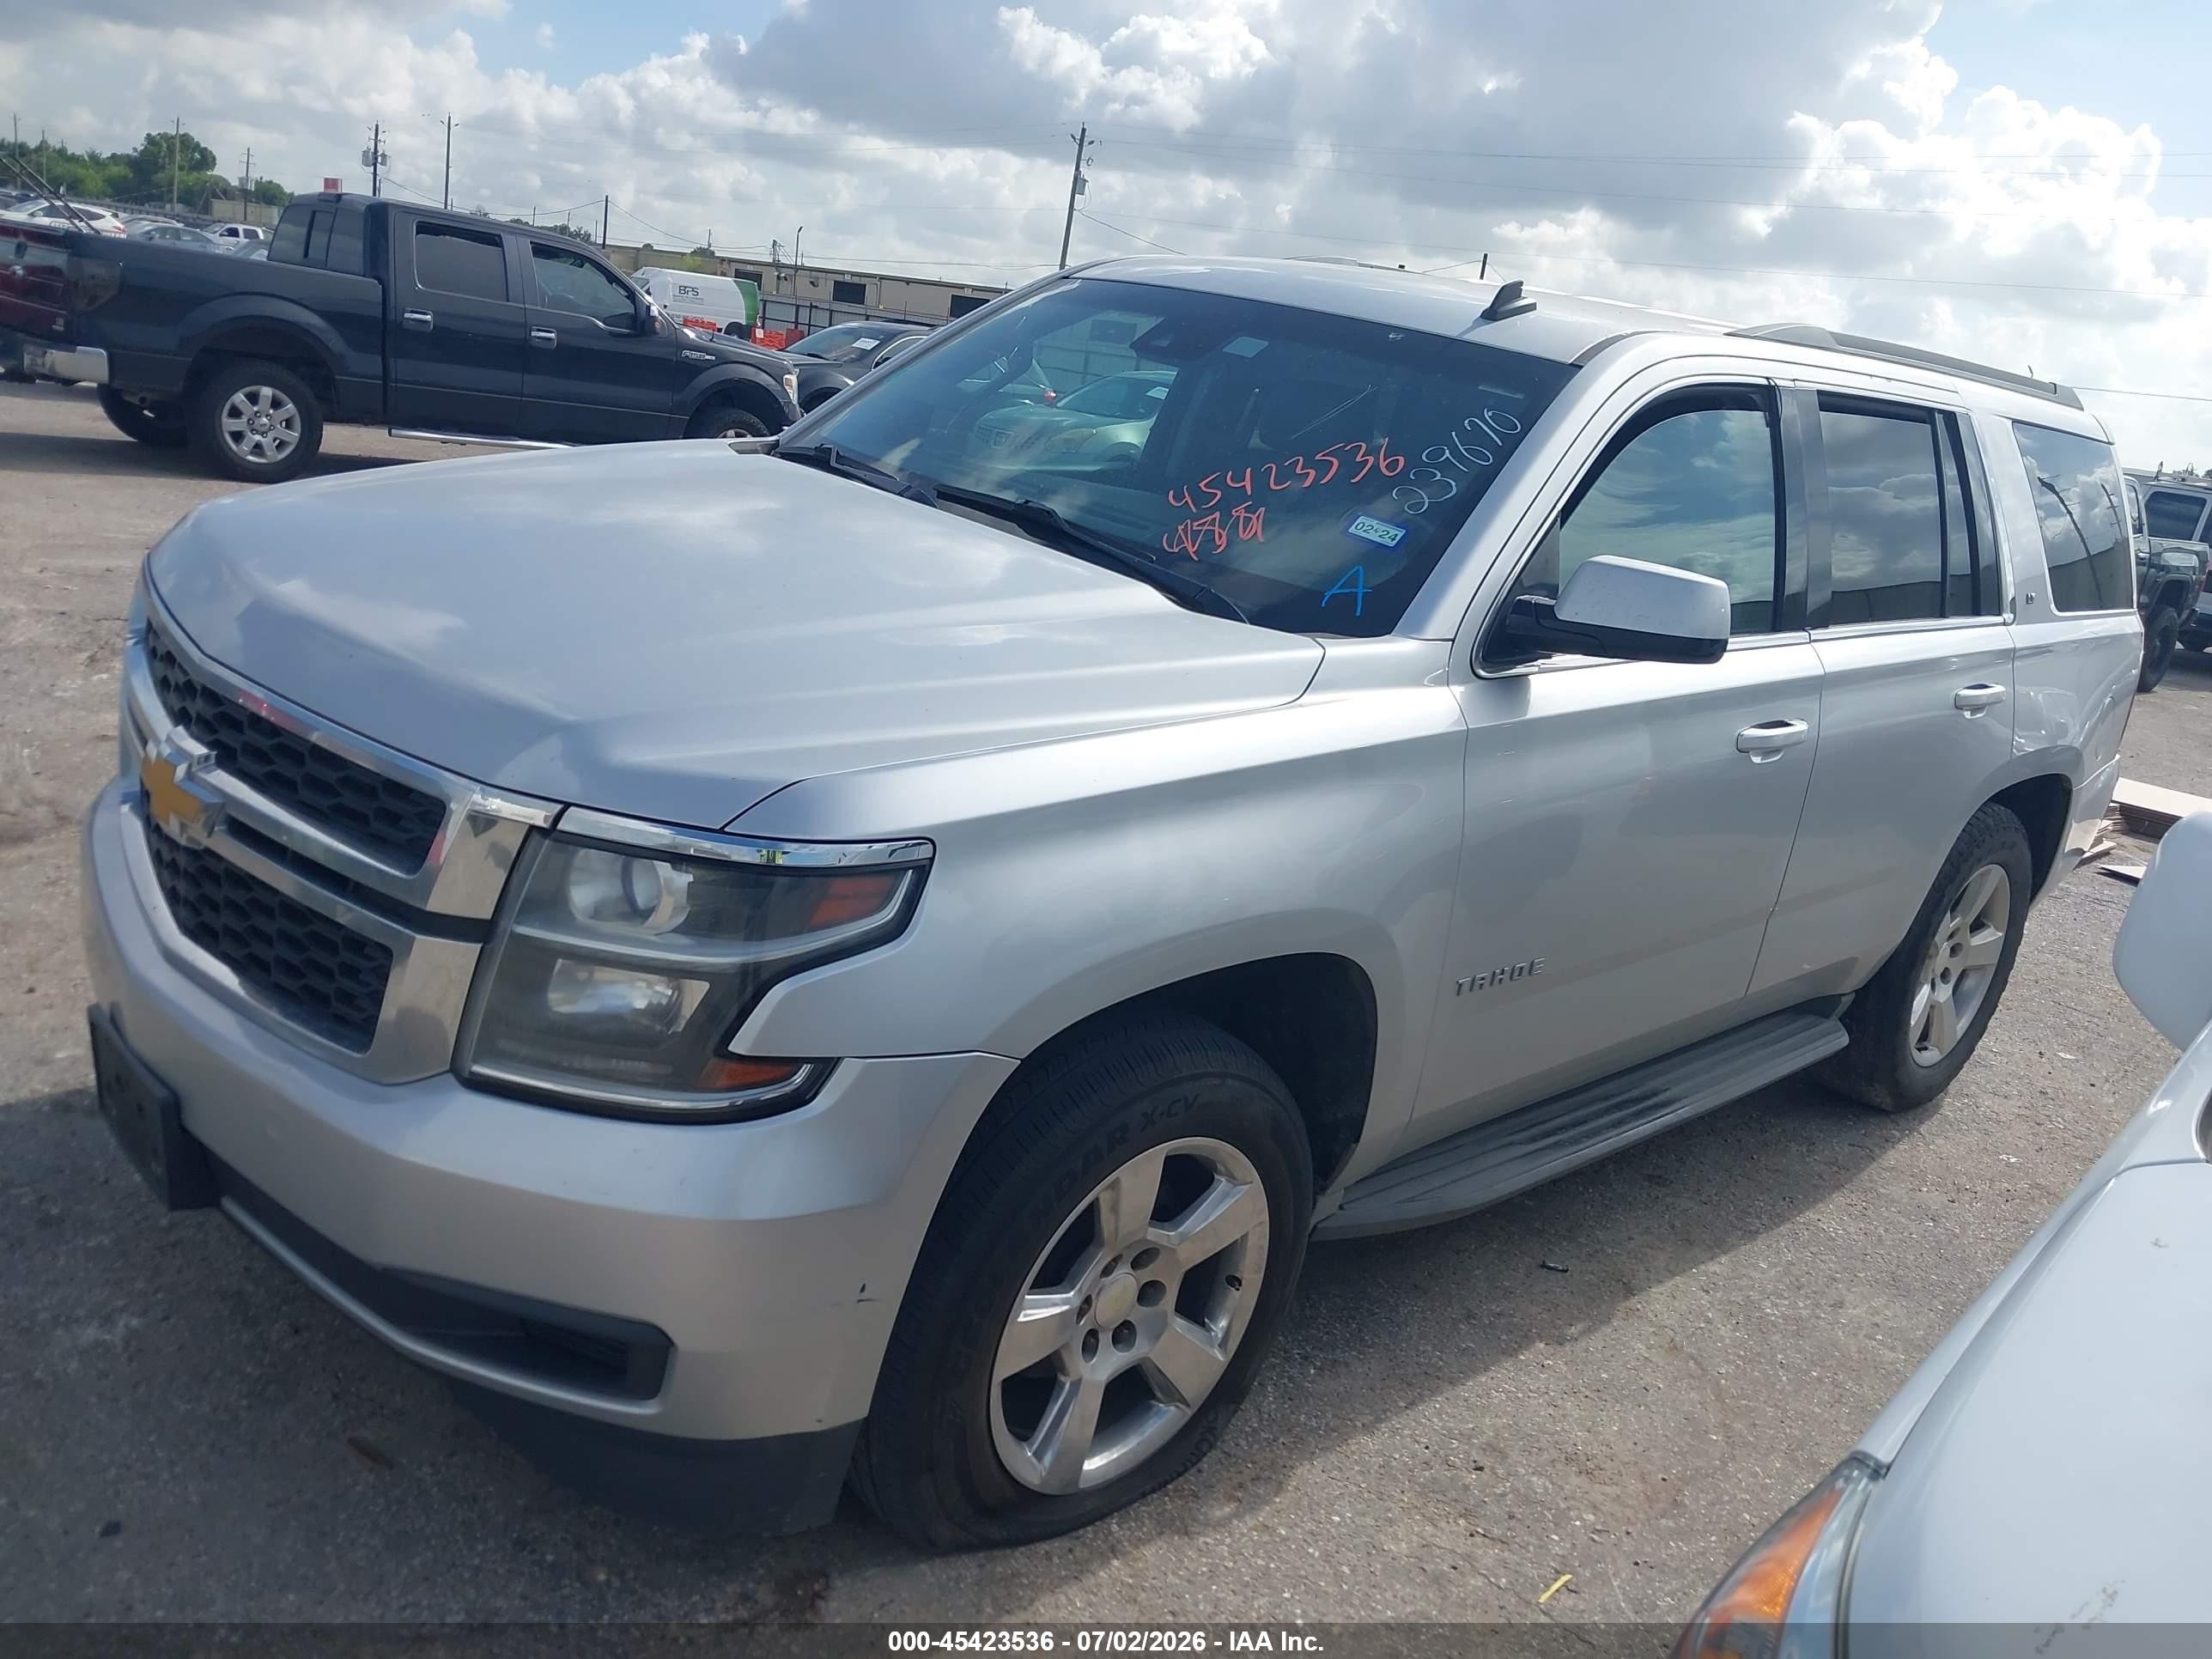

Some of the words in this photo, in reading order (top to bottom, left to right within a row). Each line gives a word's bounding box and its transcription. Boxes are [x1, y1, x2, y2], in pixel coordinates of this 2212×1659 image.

[678, 285, 699, 296] BPS
[1168, 436, 1406, 513] 45423536
[1392, 408, 1522, 514] 239670
[1322, 566, 1372, 617] A
[1455, 957, 1546, 996] TAHOE
